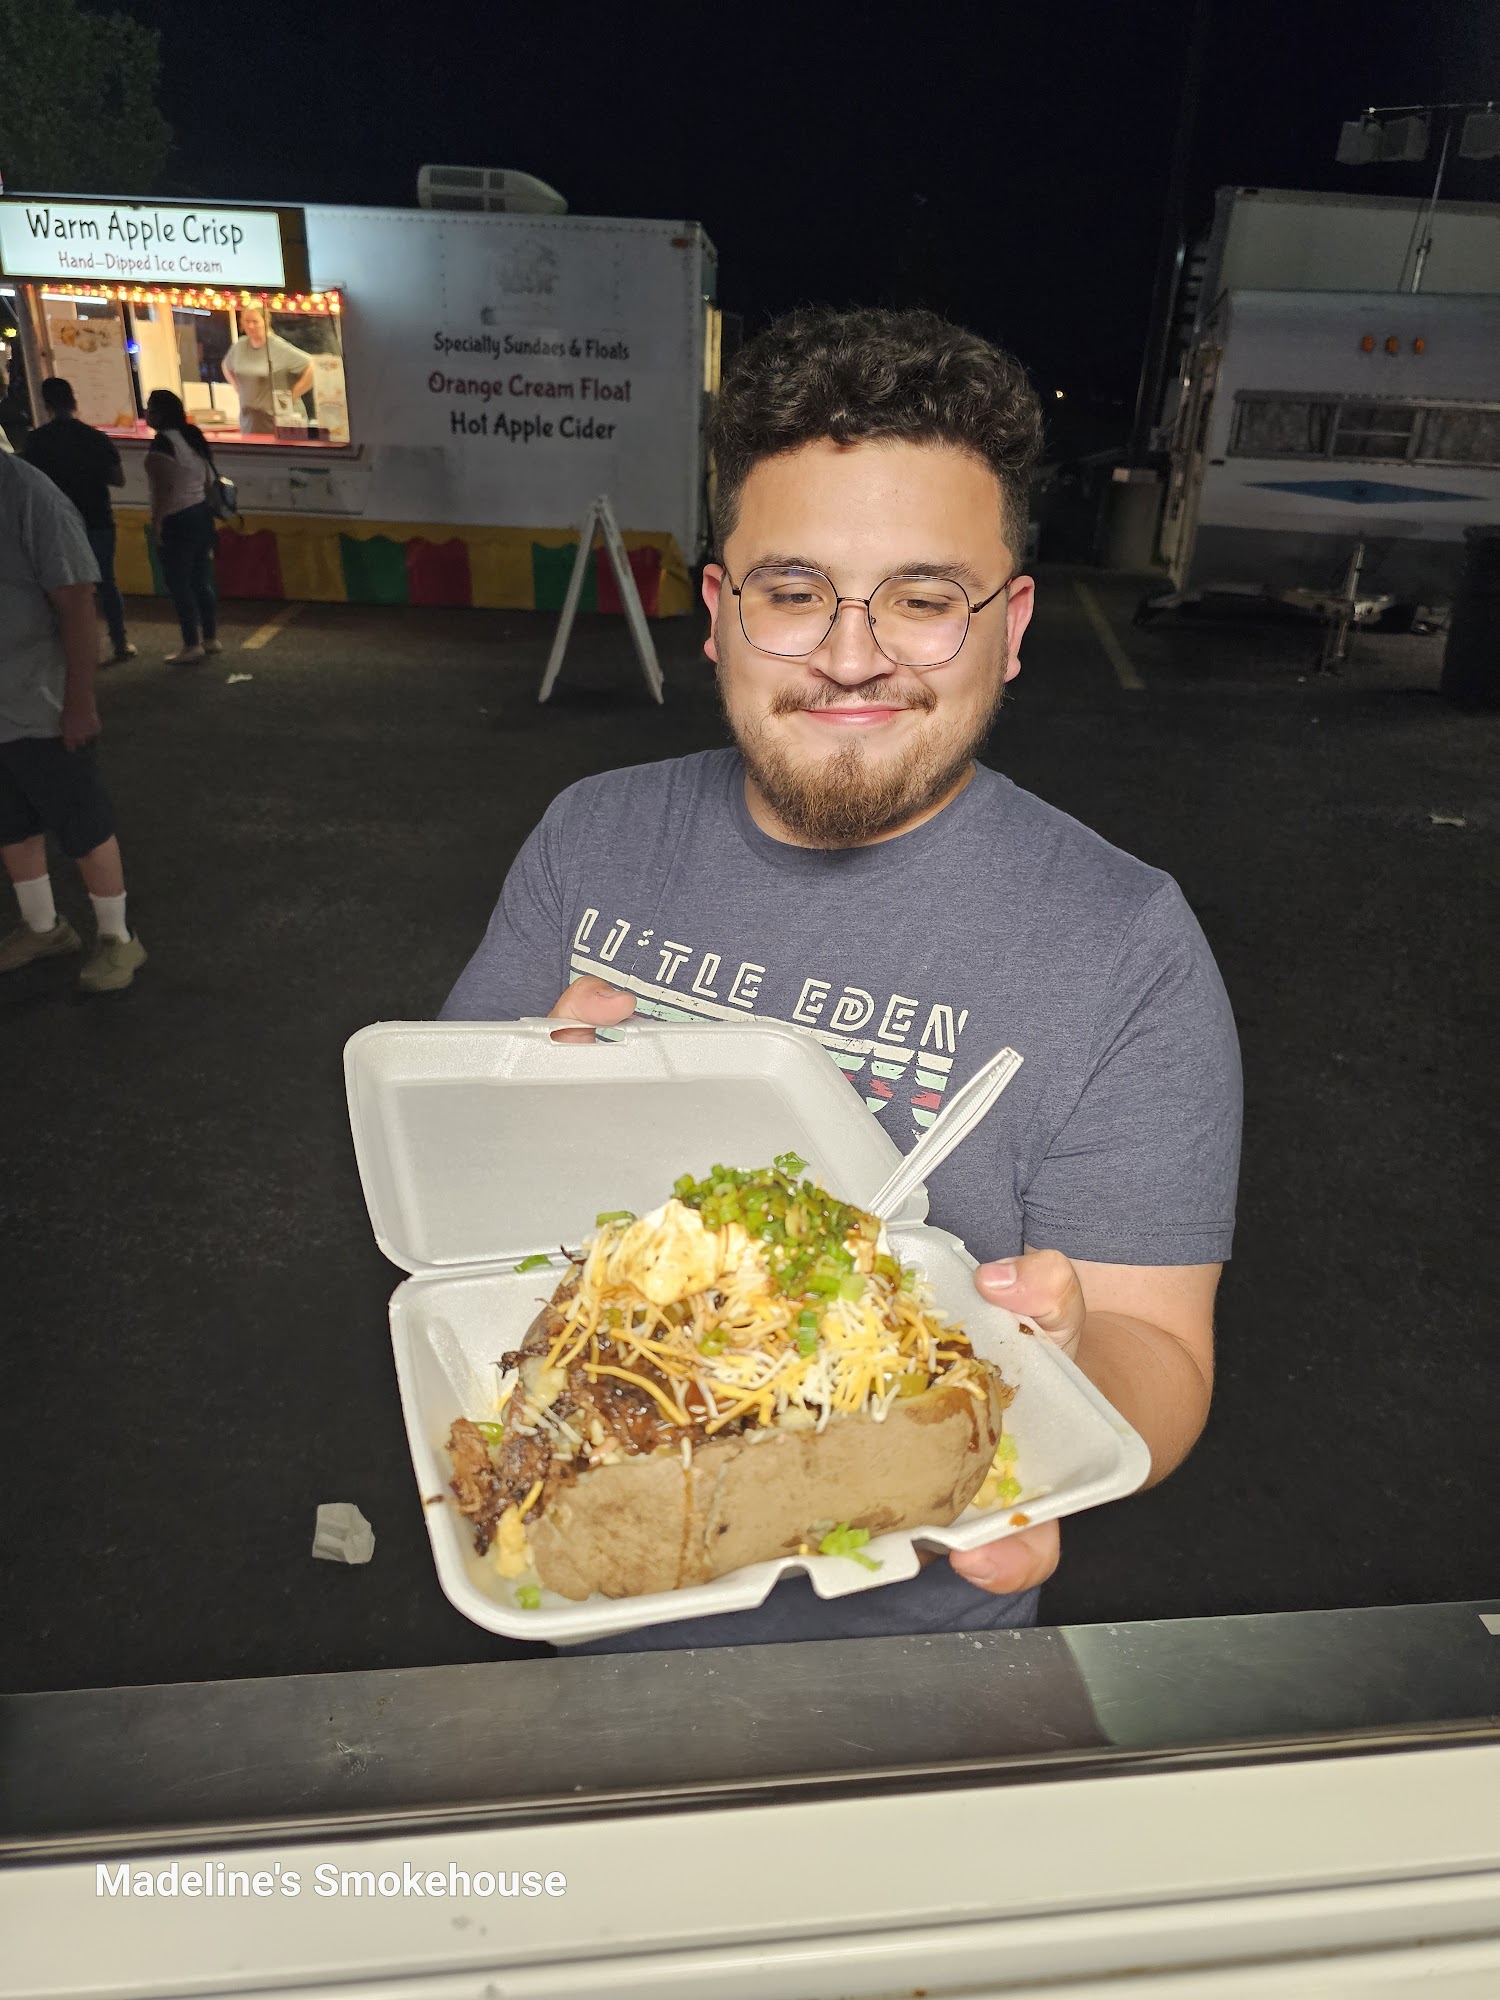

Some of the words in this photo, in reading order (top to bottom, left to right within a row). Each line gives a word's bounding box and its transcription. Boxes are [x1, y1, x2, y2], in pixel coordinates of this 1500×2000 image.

[25, 208, 100, 240] Warm
[107, 210, 176, 250] Apple
[182, 214, 244, 254] Crisp
[58, 250, 151, 274] Hand-Dipped
[155, 254, 175, 273] Ice
[178, 255, 223, 273] Cream
[433, 331, 501, 360] Specialty
[503, 334, 567, 358] Sundaes
[568, 338, 582, 358] &
[585, 338, 630, 361] Floats
[428, 370, 503, 403] Orange
[508, 373, 575, 399] Cream
[579, 376, 632, 402] Float
[450, 408, 488, 435] Hot
[493, 412, 554, 444] Apple
[559, 414, 618, 440] Cider
[573, 907, 767, 1009] LITLE
[792, 977, 969, 1053] EDEN
